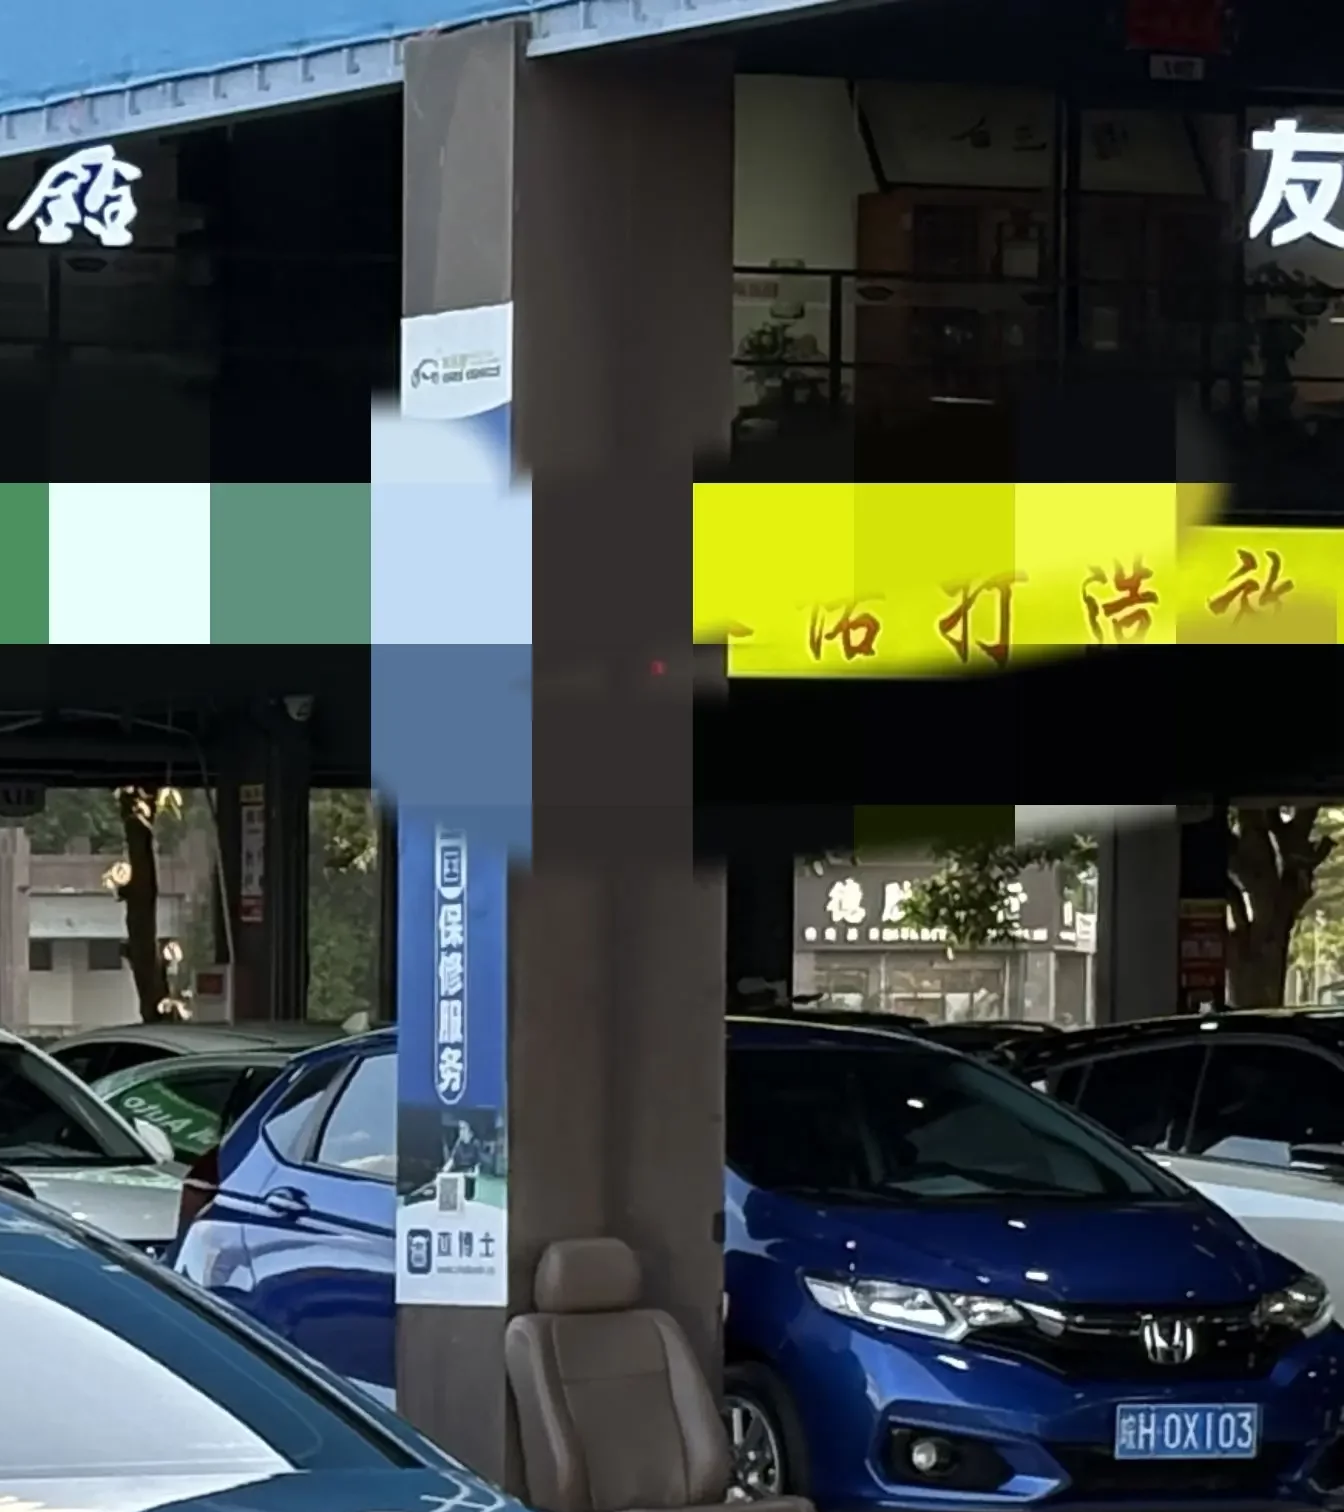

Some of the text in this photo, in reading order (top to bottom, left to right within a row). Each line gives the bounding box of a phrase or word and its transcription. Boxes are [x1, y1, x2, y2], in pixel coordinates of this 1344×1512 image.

[437, 830, 464, 1093] 国保修服务
